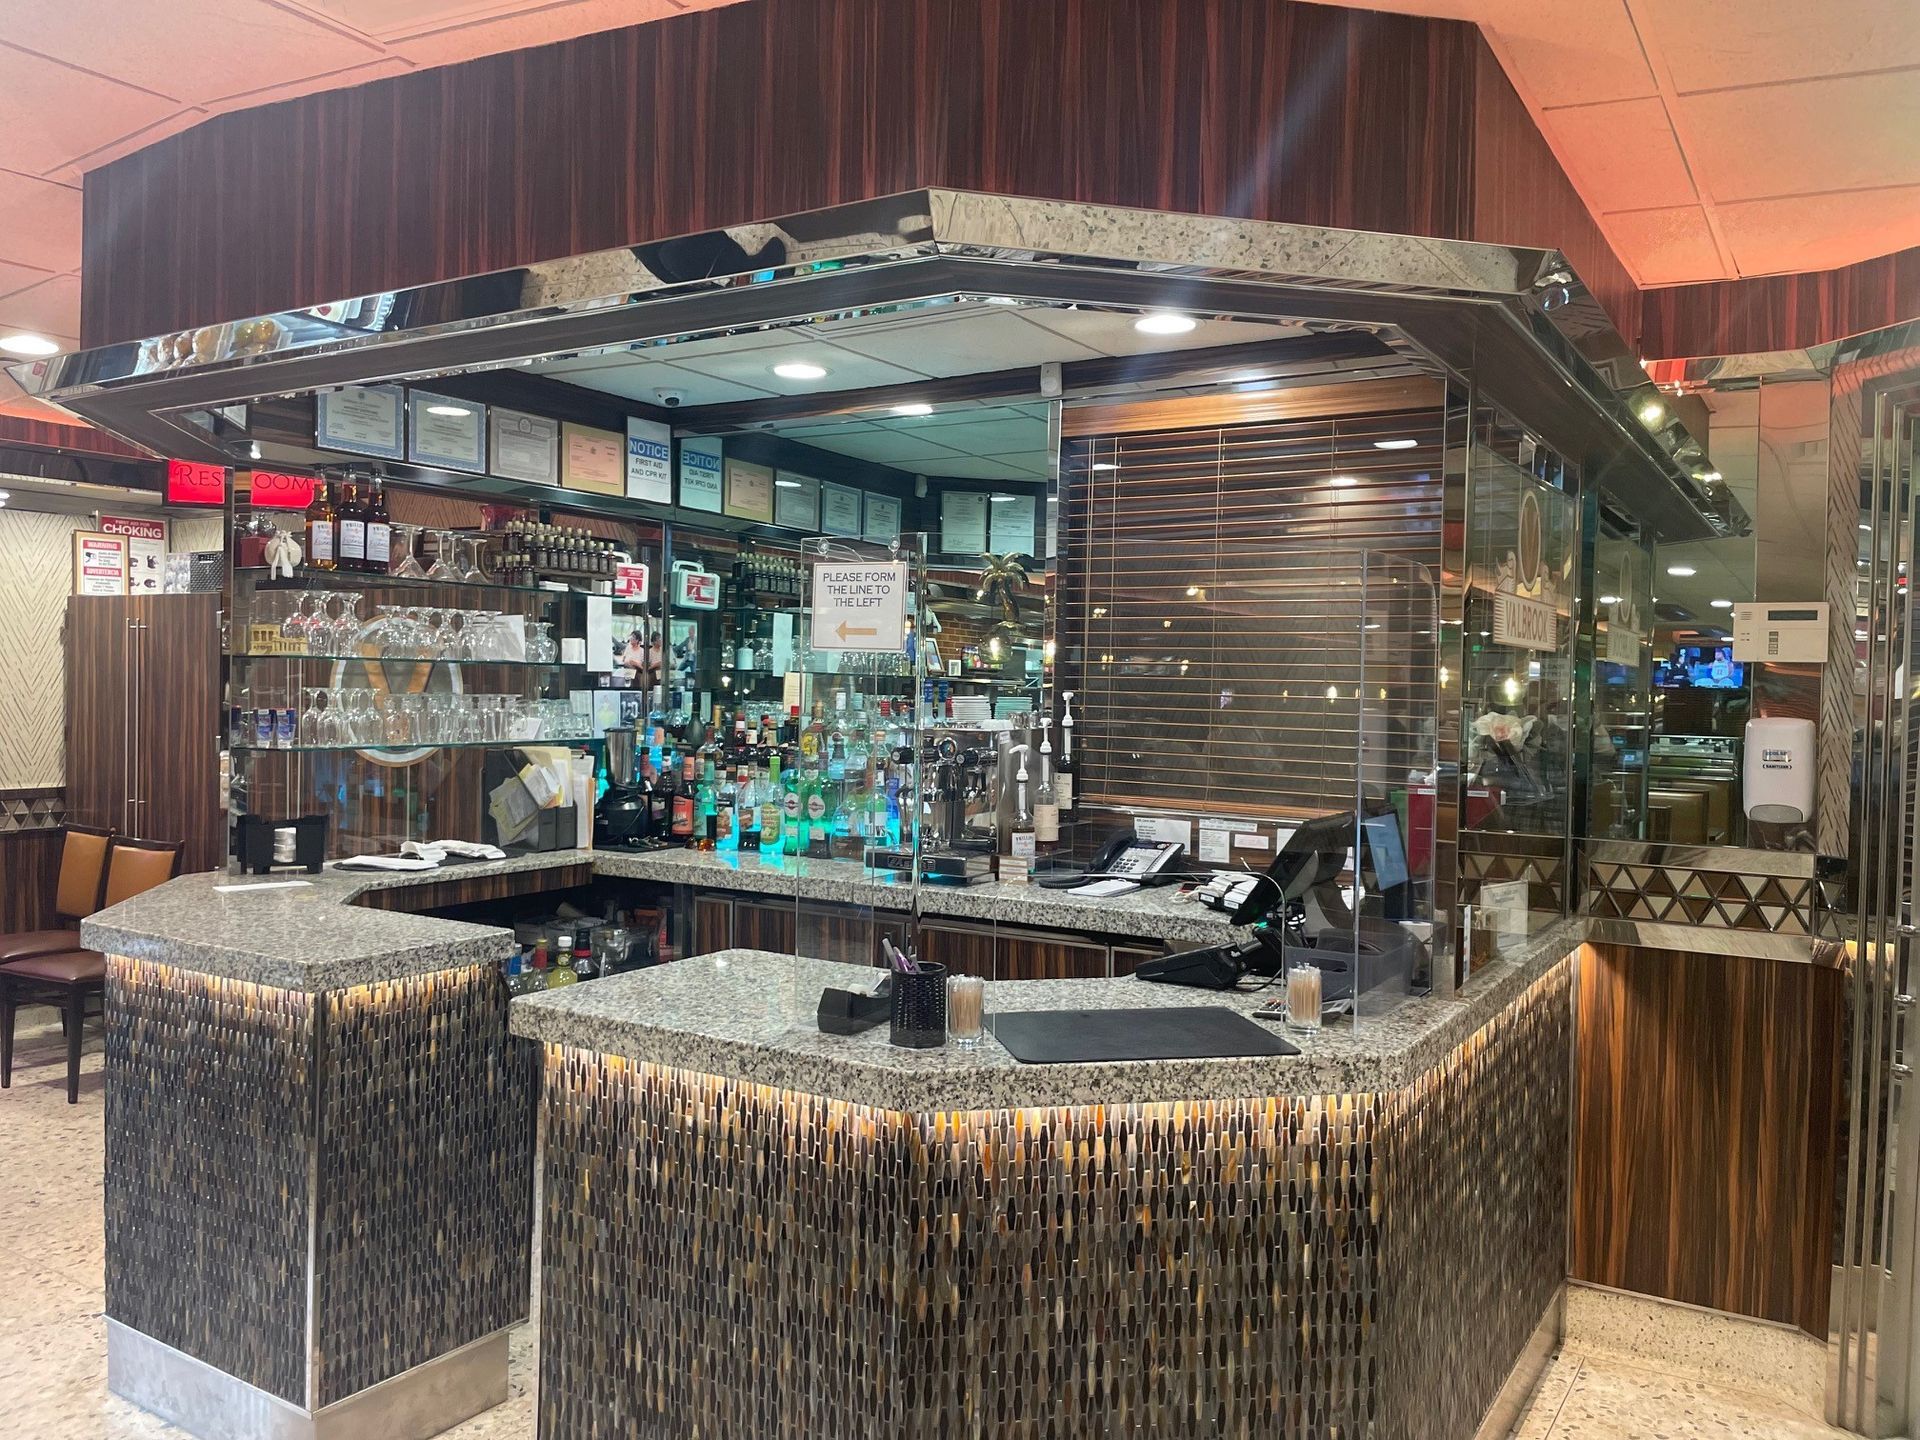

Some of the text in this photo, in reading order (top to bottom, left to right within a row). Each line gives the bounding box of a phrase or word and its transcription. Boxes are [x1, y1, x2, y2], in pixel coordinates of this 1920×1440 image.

[630, 441, 668, 459] NOTICE
[635, 458, 652, 467] FIRST
[631, 468, 644, 476] AND
[645, 470, 658, 478] CPR
[103, 523, 162, 538] CHOKING
[87, 541, 118, 549] WARNING
[823, 572, 896, 582] PLEASE FORM
[827, 585, 890, 594] THE LINE TO
[834, 598, 883, 607] THE LEFT
